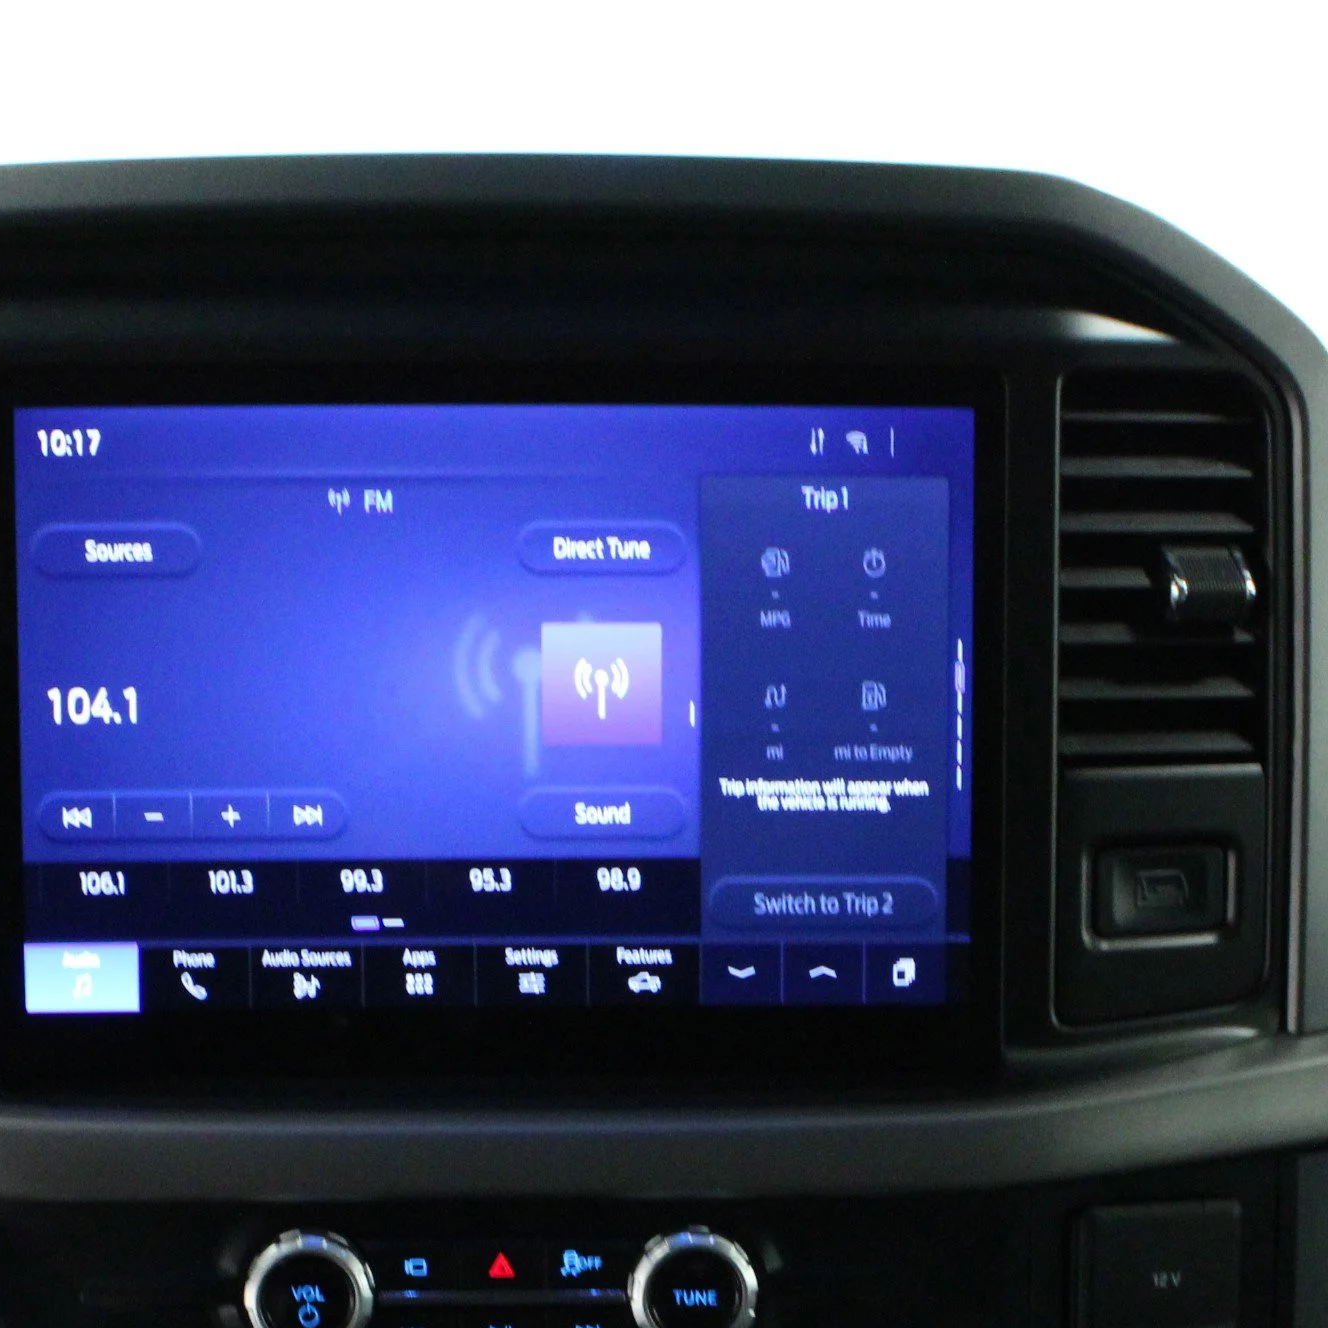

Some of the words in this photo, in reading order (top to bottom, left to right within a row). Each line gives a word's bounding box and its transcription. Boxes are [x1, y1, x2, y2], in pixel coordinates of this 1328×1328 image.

[37, 428, 101, 457] 10:17
[363, 488, 394, 514] FM
[801, 484, 838, 514] Trip
[841, 485, 849, 511] 1
[84, 539, 154, 563] Sources
[553, 535, 604, 560] Direct
[606, 535, 652, 560] Tune
[760, 609, 791, 629] MPG
[857, 608, 891, 628] Time
[47, 686, 138, 725] 104.1
[869, 743, 913, 764] Empty
[719, 777, 745, 798] Trip
[745, 777, 821, 796] information
[821, 777, 846, 796] will
[846, 780, 892, 797] appear
[893, 777, 930, 797] when
[575, 801, 632, 826] Sound
[79, 870, 126, 896] 106.1
[208, 869, 254, 894] 101.3
[596, 866, 642, 892] 98.9
[754, 892, 816, 916] Switch
[820, 893, 839, 915] to
[841, 892, 879, 917] Trip
[881, 892, 894, 915] 2
[173, 949, 215, 968] Phone
[261, 948, 300, 968] Audio
[300, 948, 352, 968] Sources
[402, 947, 436, 969] Apps
[505, 947, 559, 968] Settings
[616, 946, 673, 966] Features
[291, 1285, 325, 1303] VOL
[672, 1288, 718, 1308] TUNE
